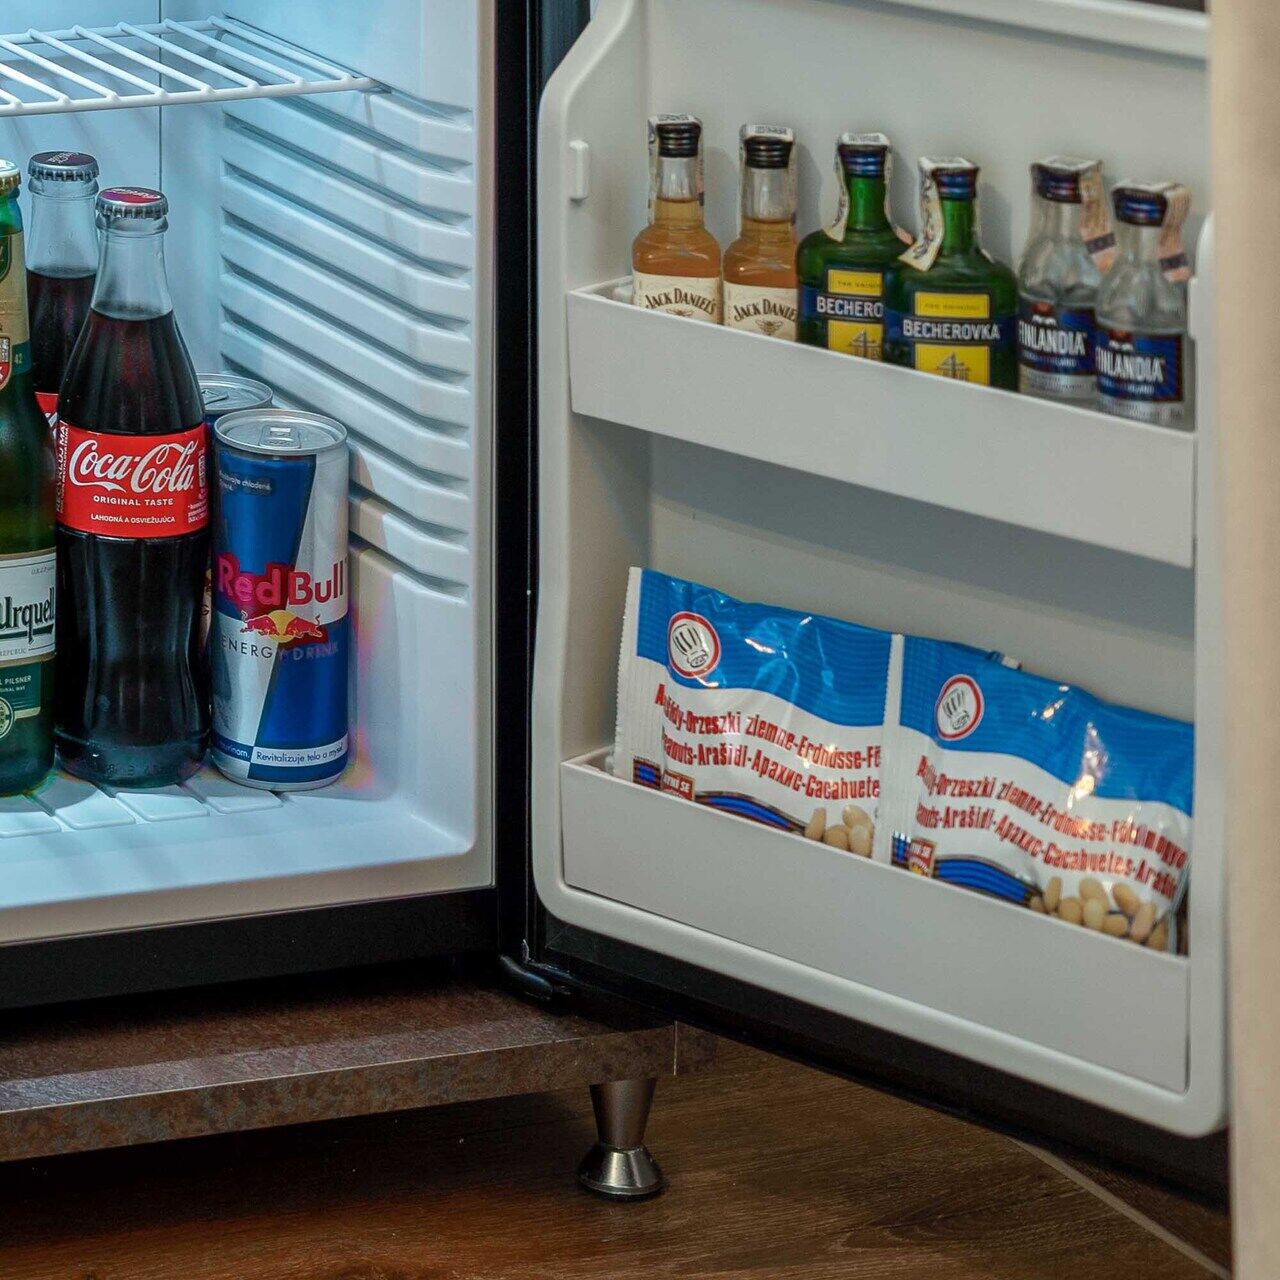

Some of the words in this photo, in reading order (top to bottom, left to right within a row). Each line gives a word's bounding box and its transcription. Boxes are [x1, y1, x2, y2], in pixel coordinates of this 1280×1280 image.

[645, 291, 672, 310] JACK
[734, 301, 761, 322] JACK
[903, 319, 1000, 340] BECHEROVKA
[69, 439, 198, 494] Coca-Cola
[93, 495, 141, 506] ORIGINAL
[145, 498, 174, 506] TASTE
[91, 513, 123, 523] LAHODNÁ
[219, 556, 281, 606] Red
[288, 560, 343, 606] Bull
[5, 675, 32, 685] PILSNER
[257, 751, 305, 765] Revitalizuje
